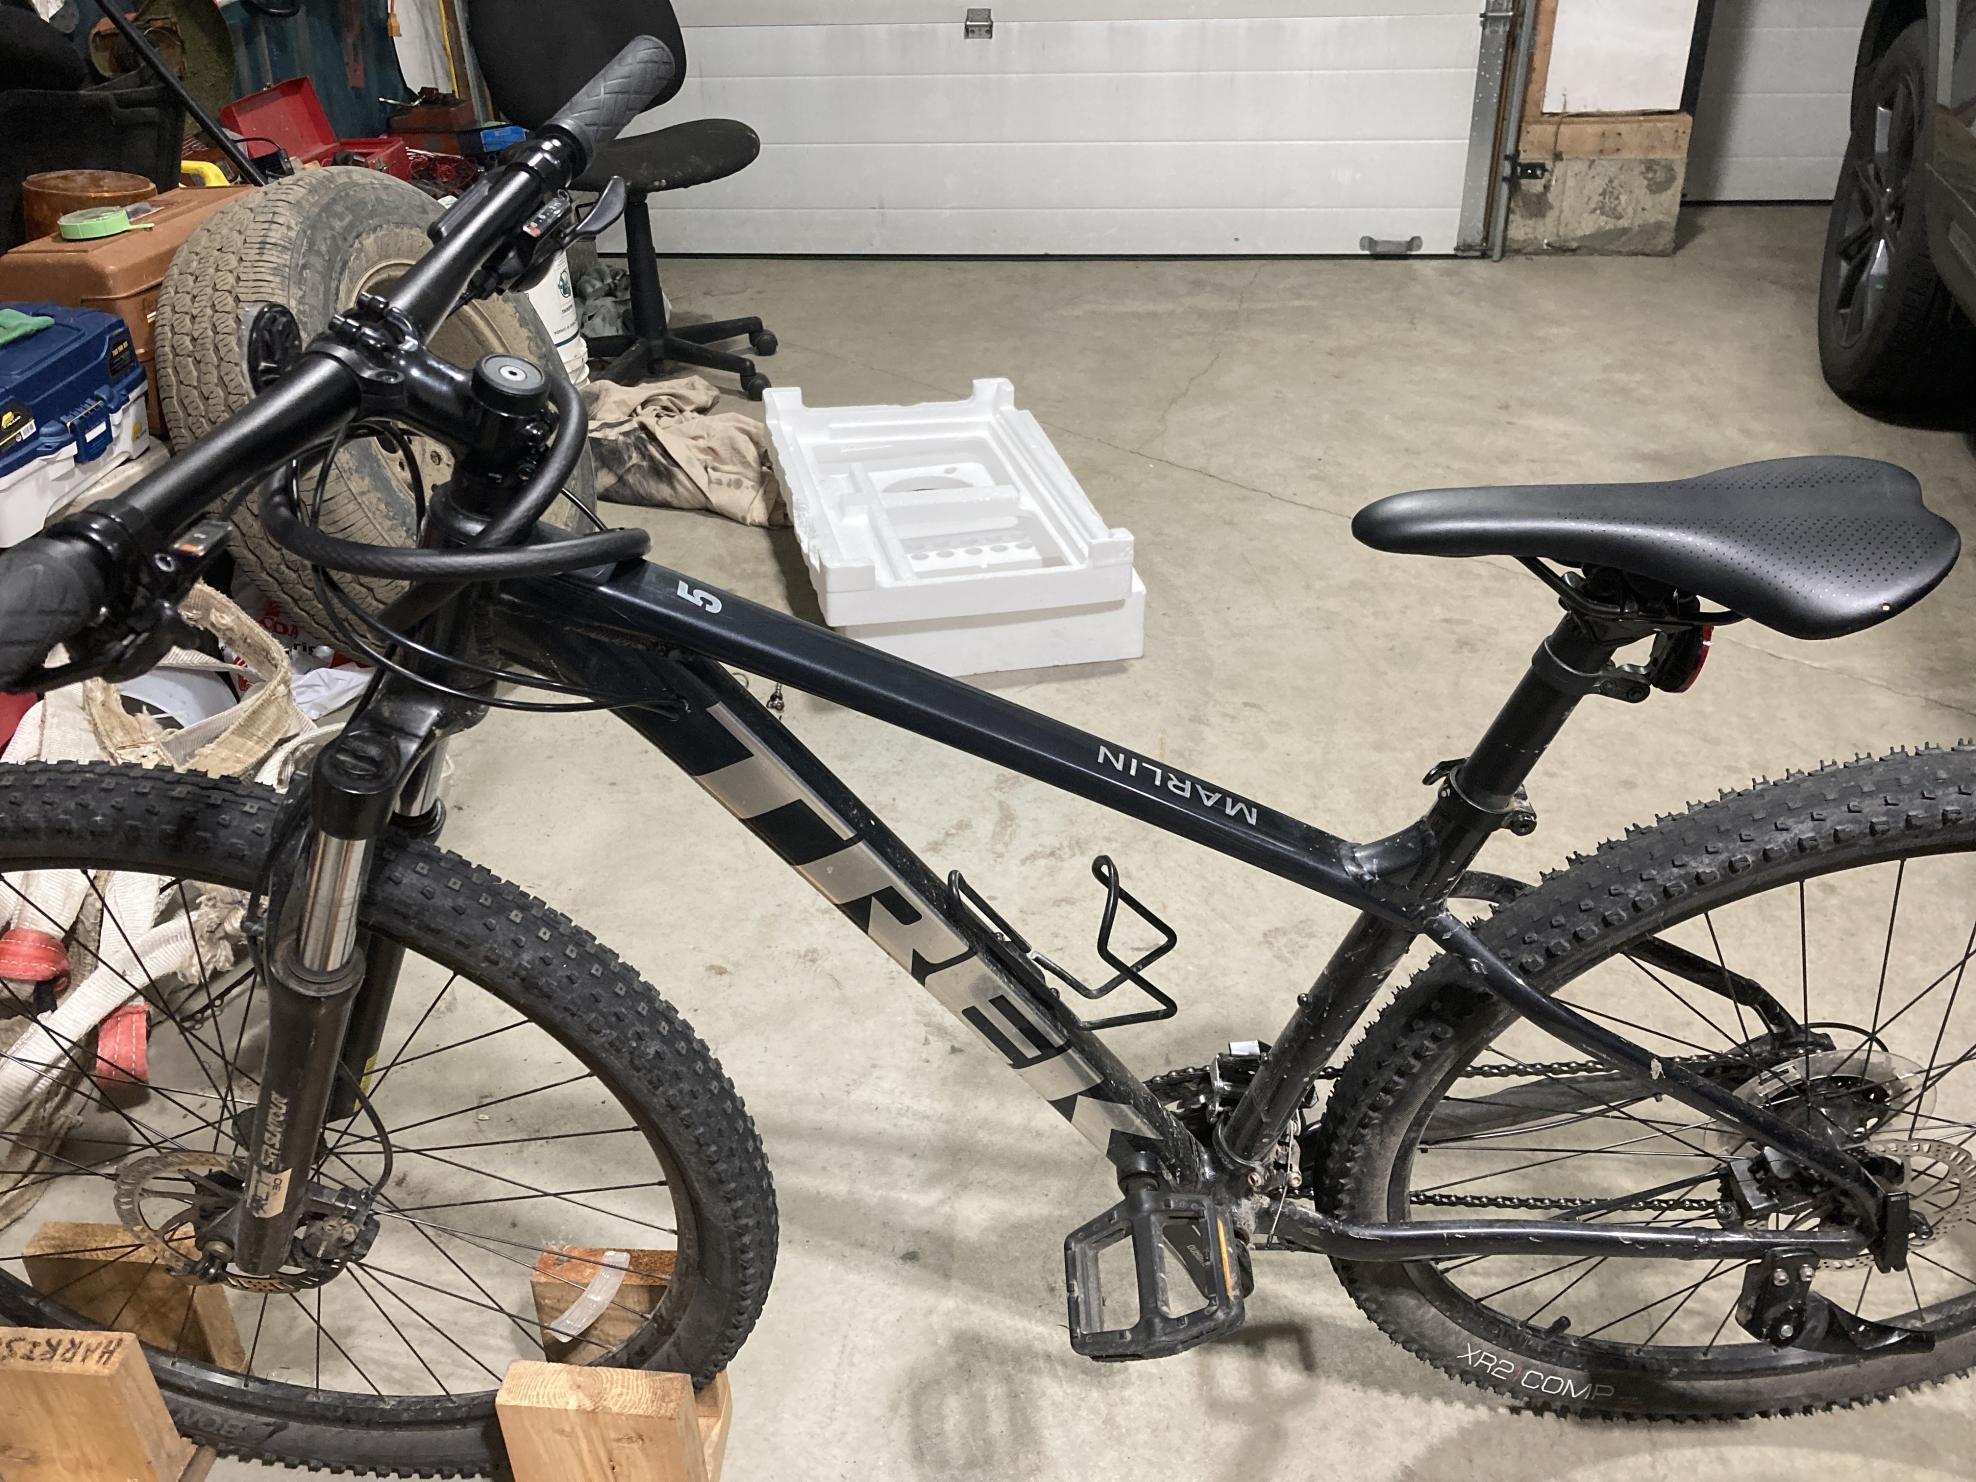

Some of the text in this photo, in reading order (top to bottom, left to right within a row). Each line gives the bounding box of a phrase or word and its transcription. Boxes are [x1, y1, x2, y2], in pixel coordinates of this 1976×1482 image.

[675, 580, 724, 615] 5
[1097, 744, 1258, 828] MARLIN
[272, 1178, 283, 1193] 30
[0, 1338, 123, 1365] HARRIS
[1457, 1343, 1615, 1401] XR2 COMP
